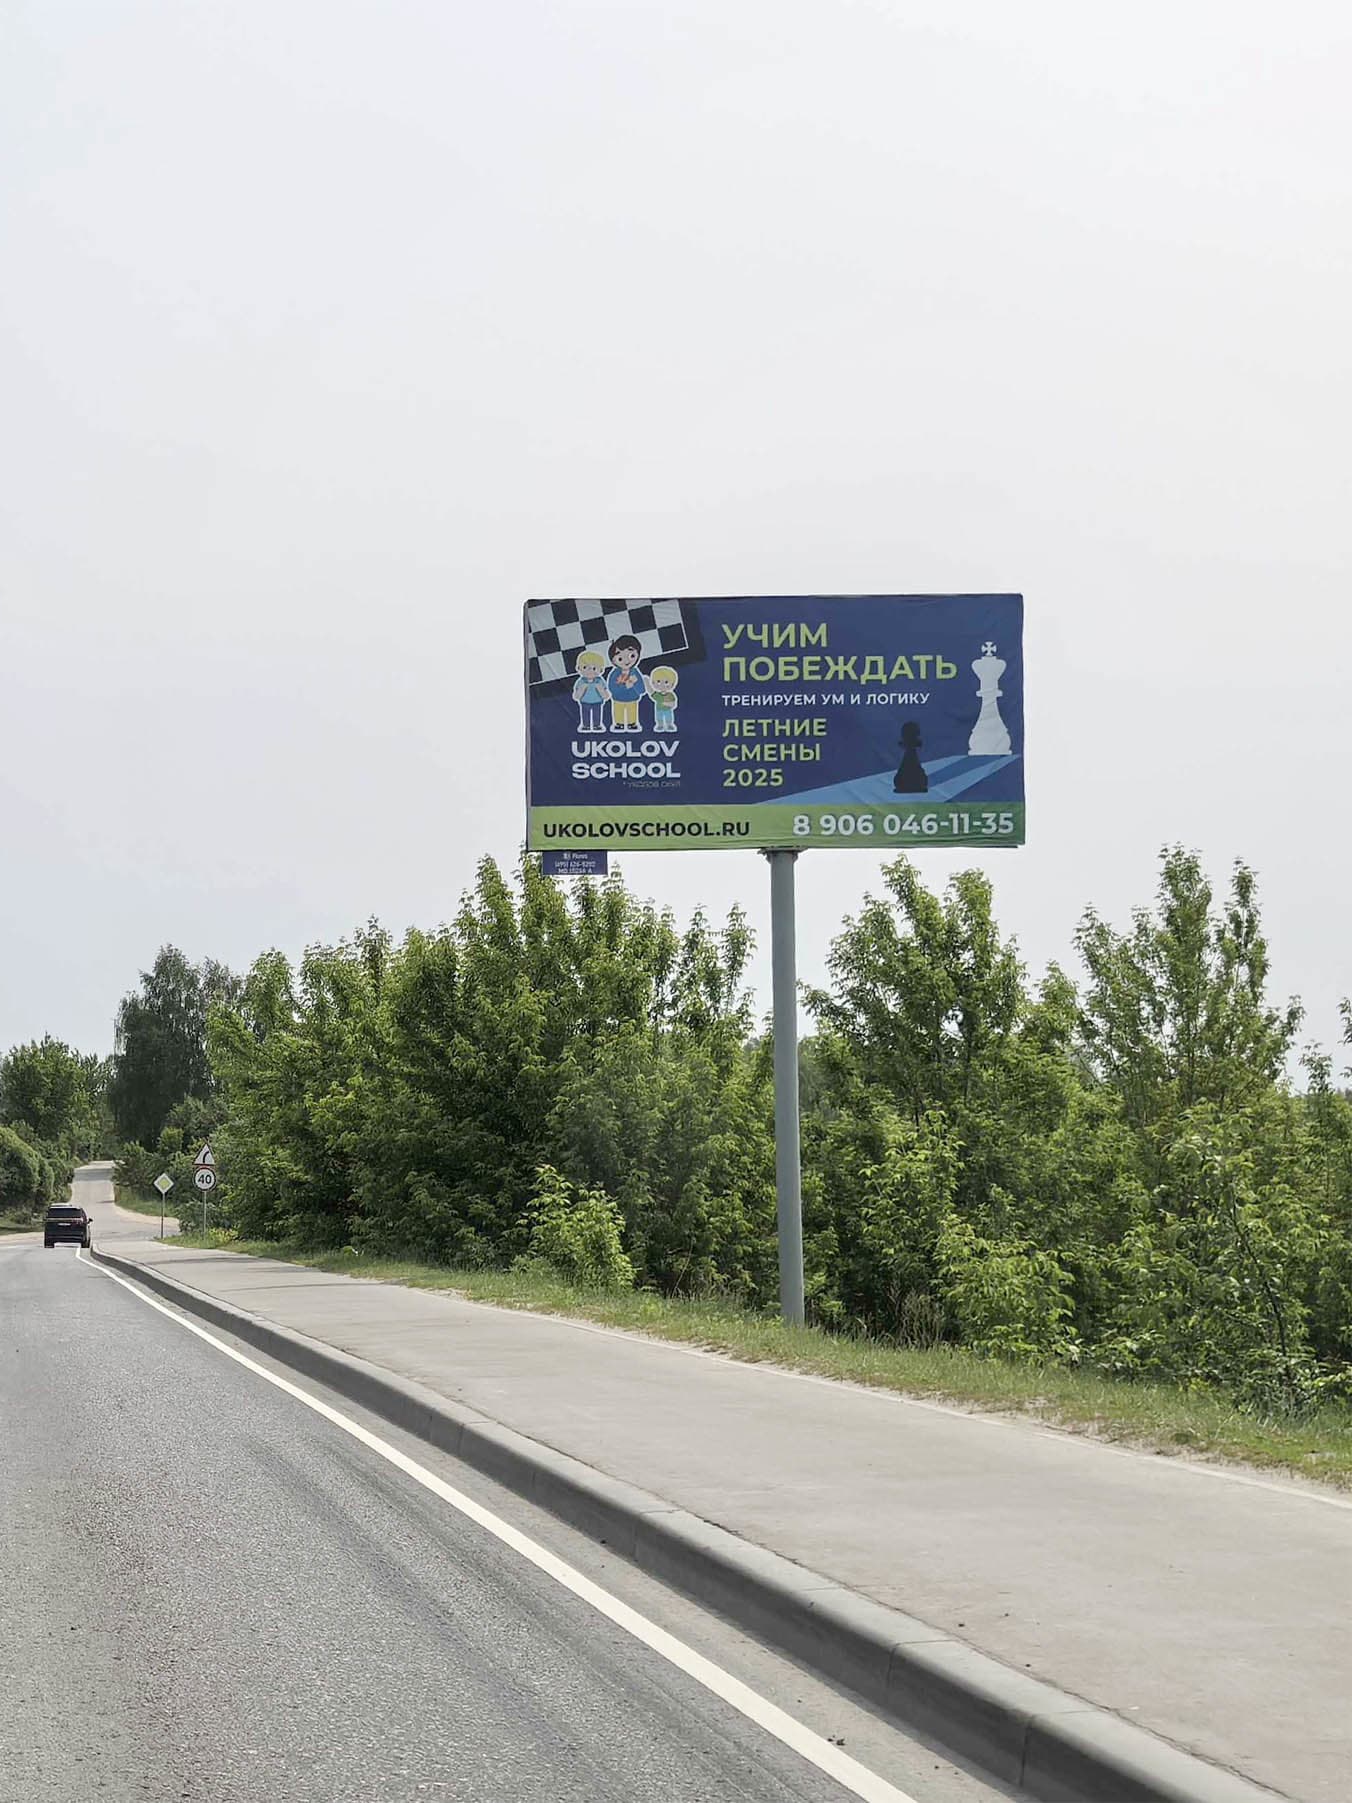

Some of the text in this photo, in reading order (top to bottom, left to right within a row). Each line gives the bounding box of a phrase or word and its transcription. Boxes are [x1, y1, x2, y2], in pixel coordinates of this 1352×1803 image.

[721, 622, 828, 649] УЧИМ
[722, 654, 958, 685] ПОБЕЖДАТЬ
[722, 692, 930, 707] ТРЕНИРУЕМ УМ И ЛОГИКУ
[722, 718, 827, 737] ЛЕТНИЕ
[571, 740, 680, 758] UKOLOV
[723, 743, 821, 762] СМЕНЫ
[571, 762, 681, 779] SCHOOL
[723, 768, 784, 787] 2025
[543, 822, 750, 838] UKOLOVSCHOOL.RU
[792, 812, 1014, 836] 8 906 046-11-35
[198, 1174, 212, 1185] 40
